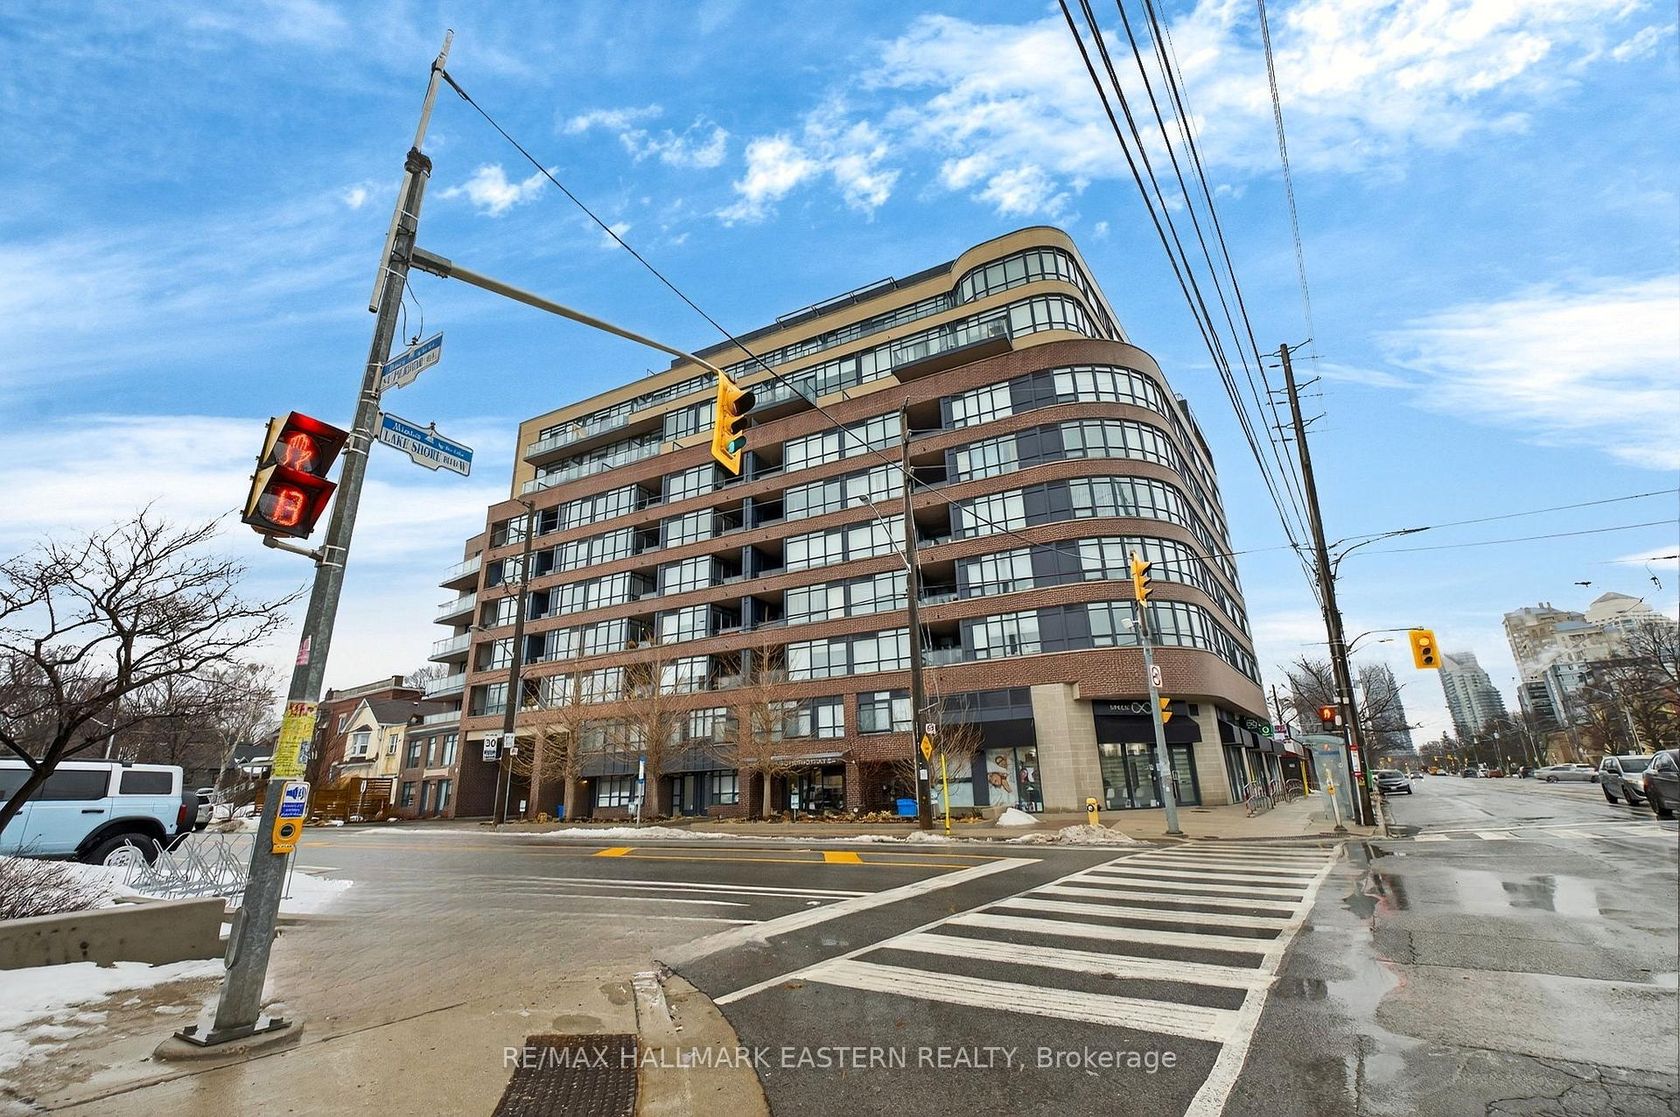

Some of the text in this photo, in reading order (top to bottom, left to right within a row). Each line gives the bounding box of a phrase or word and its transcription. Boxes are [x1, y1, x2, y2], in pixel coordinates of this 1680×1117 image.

[384, 430, 410, 449] LAKE
[411, 441, 442, 463] SHORE
[485, 738, 496, 748] 30
